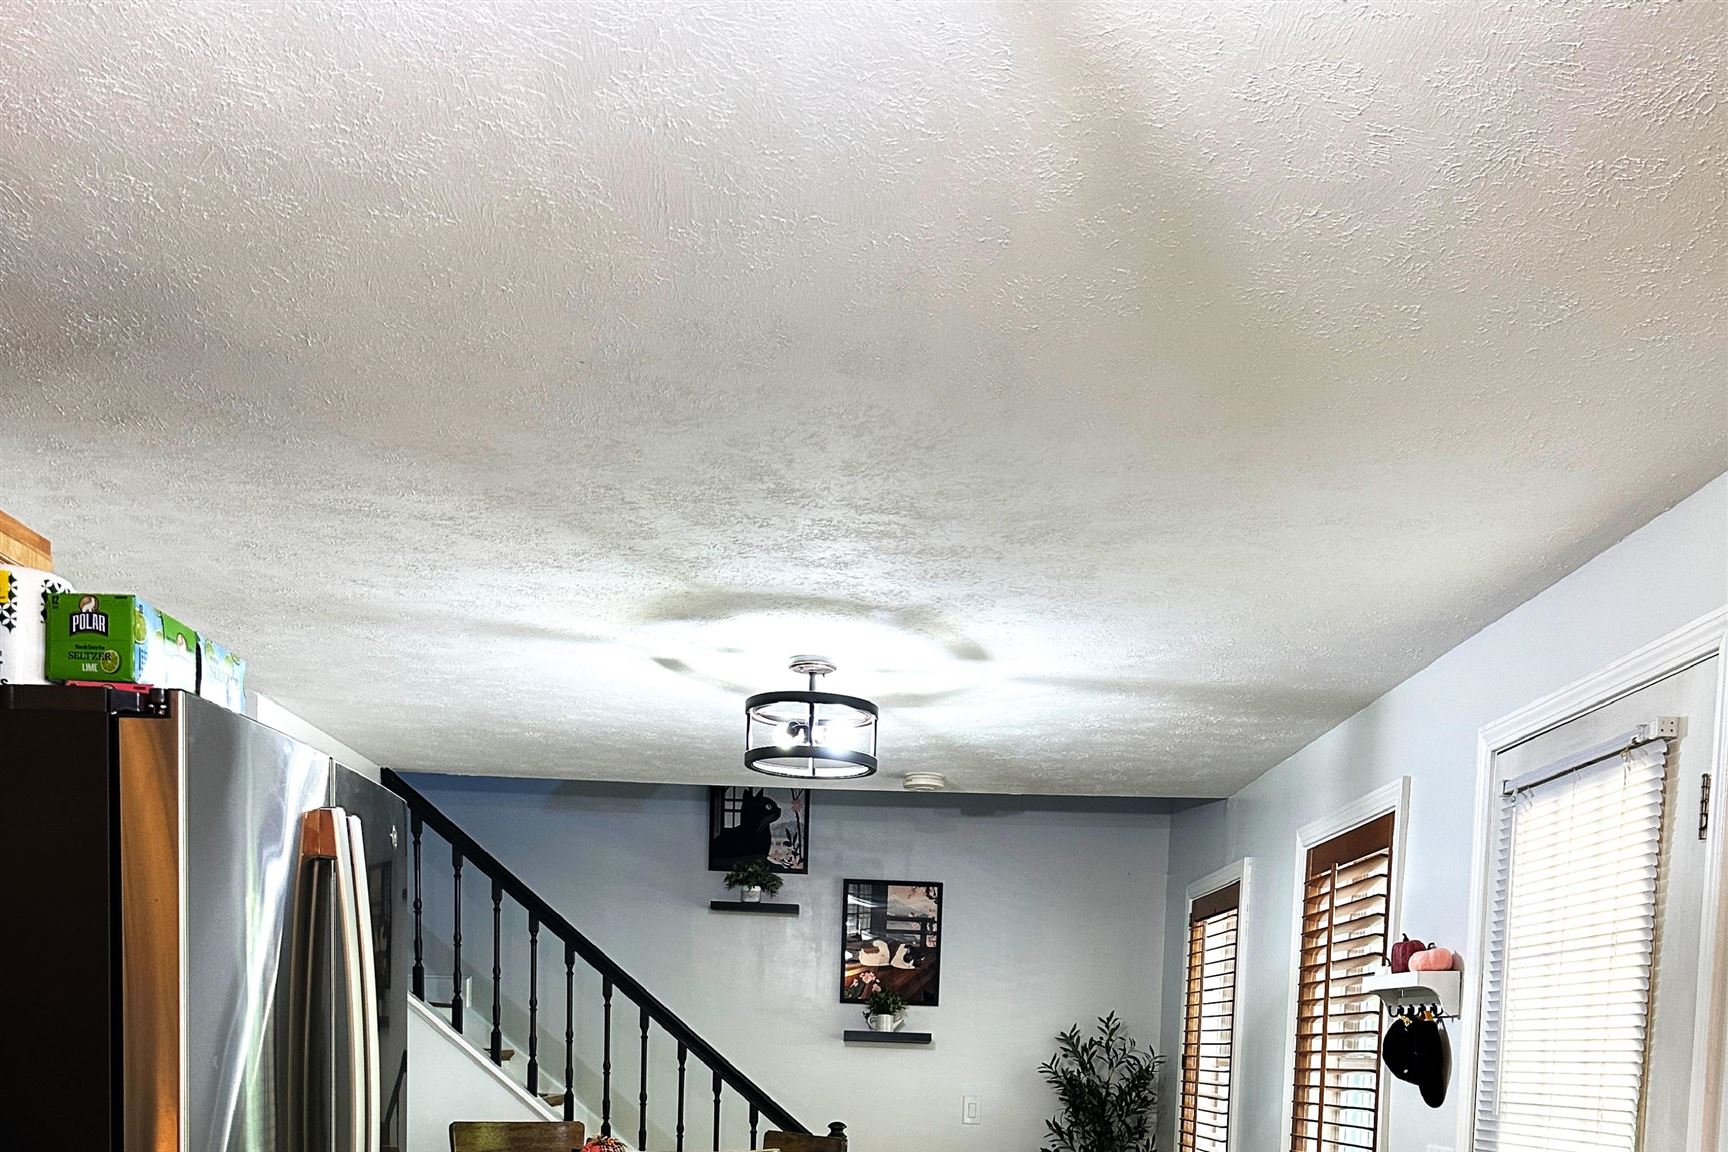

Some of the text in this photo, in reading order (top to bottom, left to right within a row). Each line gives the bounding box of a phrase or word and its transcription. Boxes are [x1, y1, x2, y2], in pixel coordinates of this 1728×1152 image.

[72, 613, 105, 632] POLAR
[68, 651, 111, 661] SELTZER
[82, 663, 98, 672] LIME
